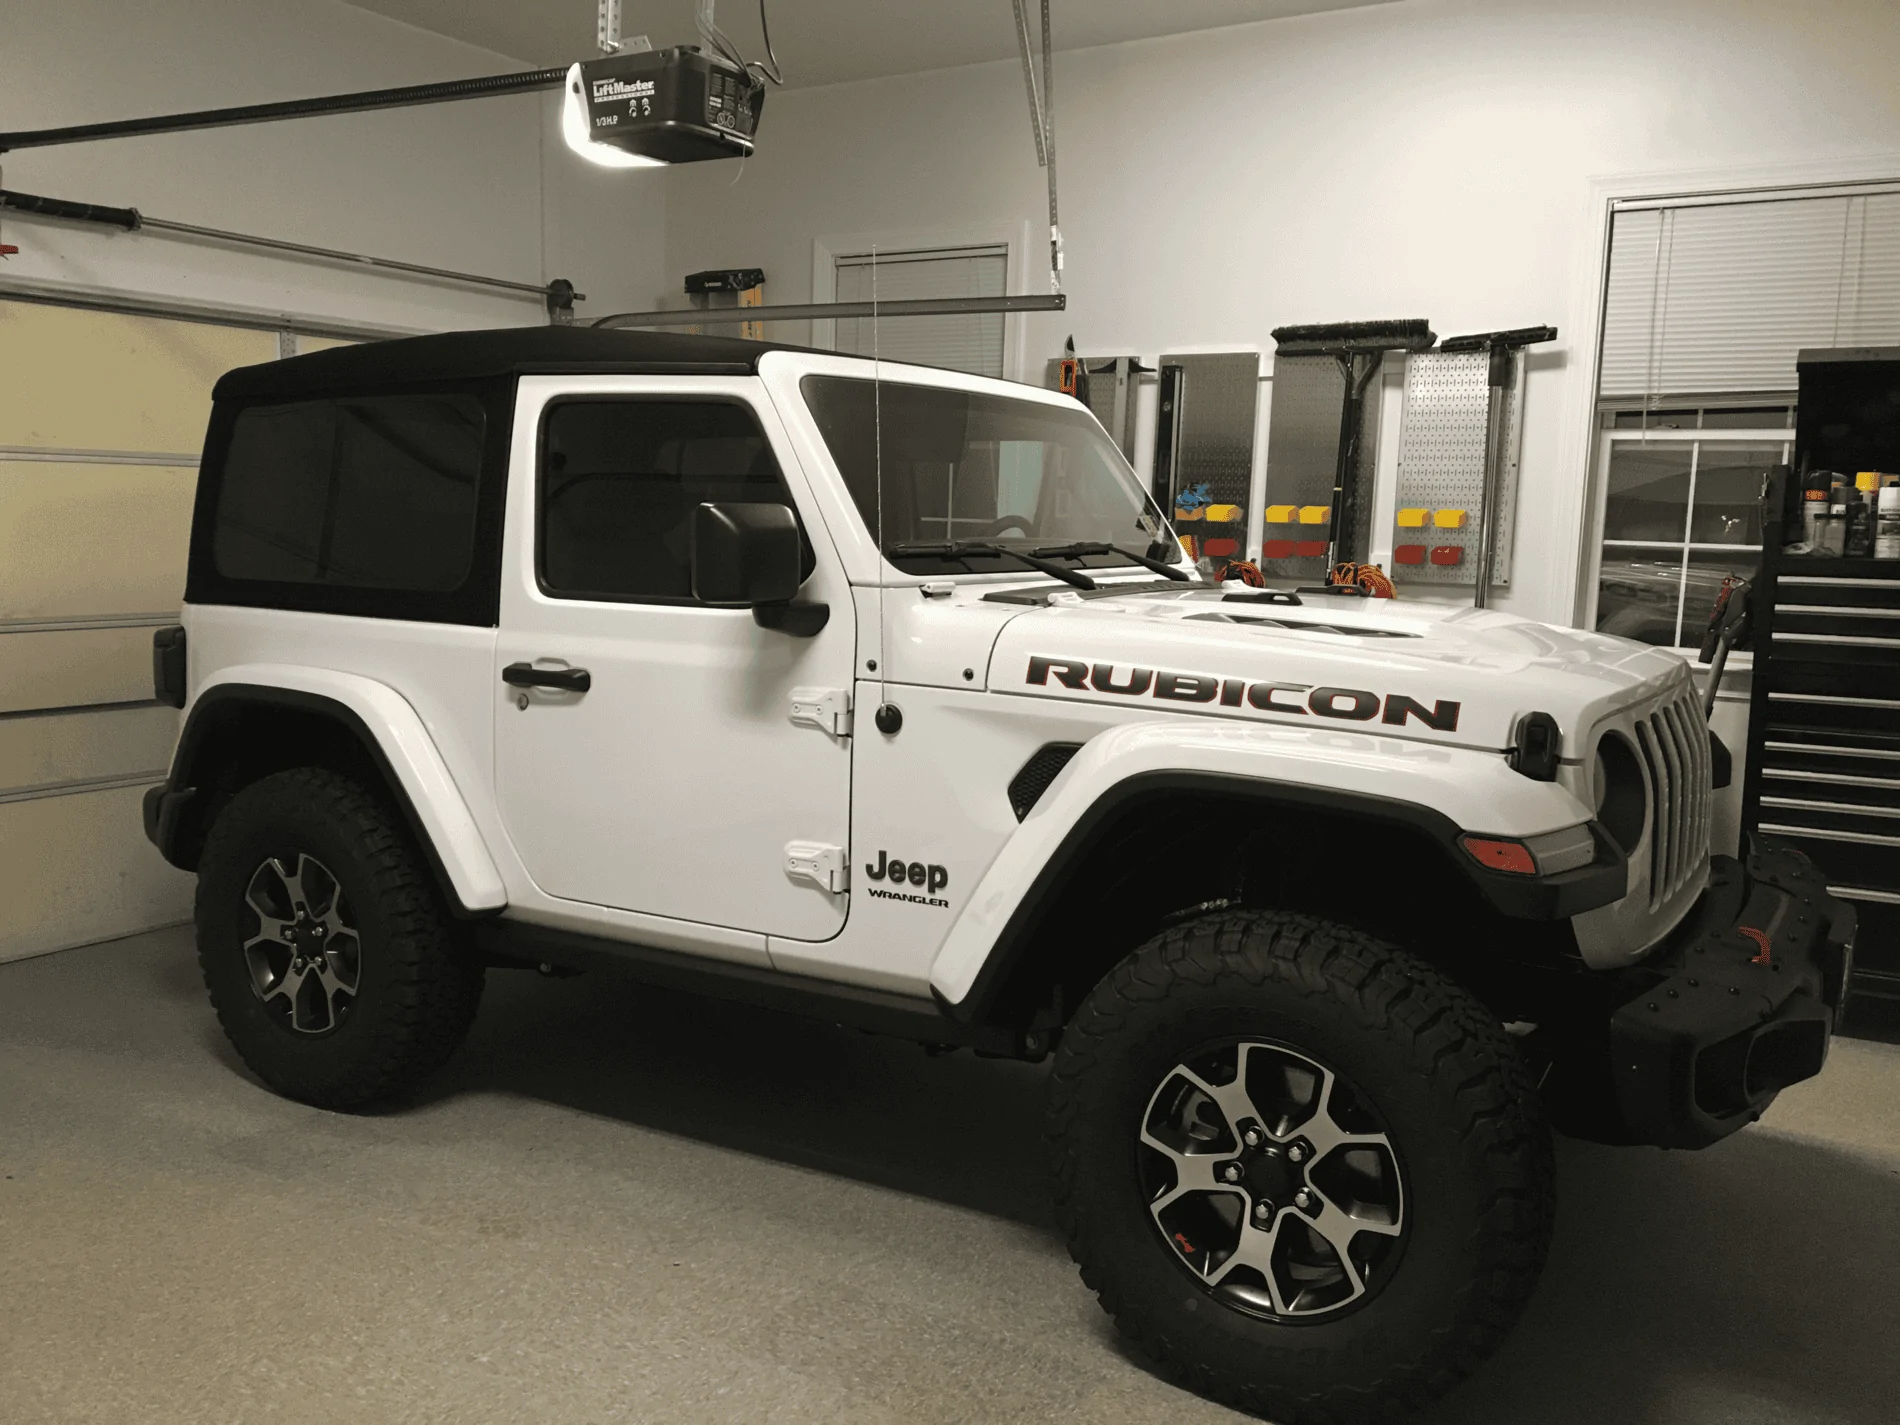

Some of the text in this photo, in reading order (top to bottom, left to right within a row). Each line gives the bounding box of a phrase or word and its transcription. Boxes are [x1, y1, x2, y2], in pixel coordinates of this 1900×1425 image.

[593, 79, 655, 97] LiftMaster
[1025, 655, 1462, 732] RUBICON
[865, 849, 949, 894] Jeep
[867, 888, 949, 909] WRANGLER
